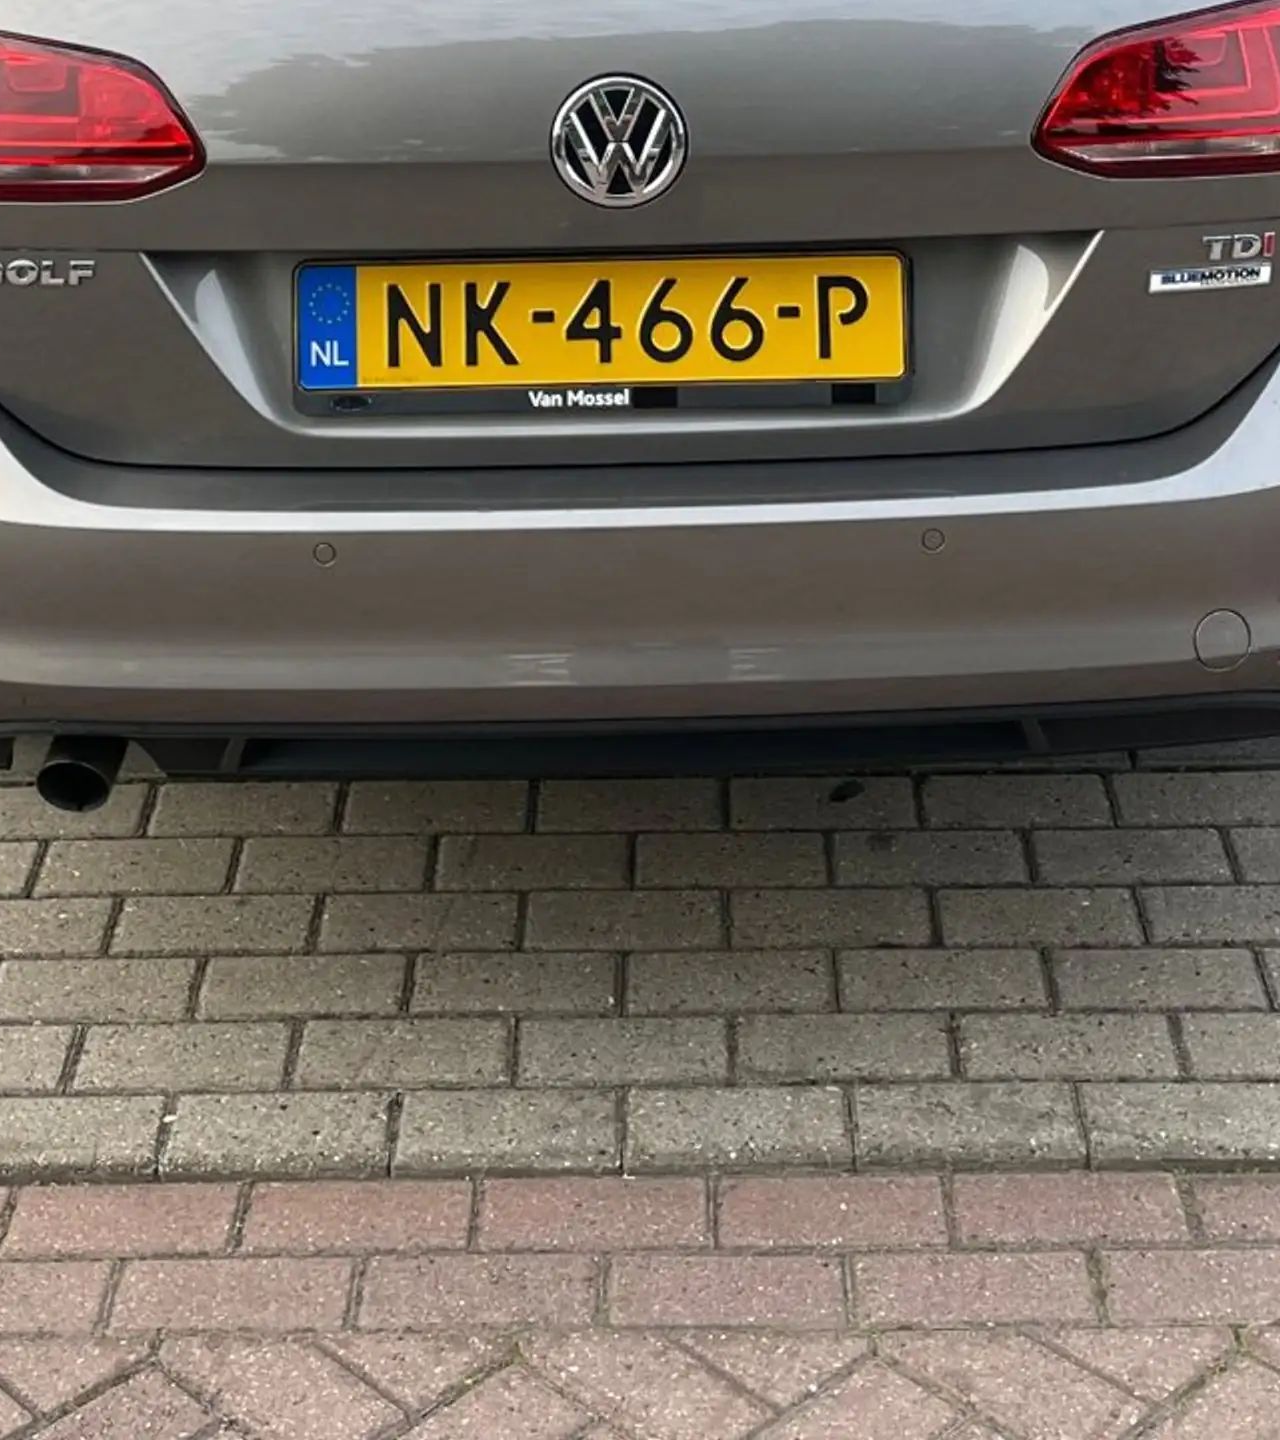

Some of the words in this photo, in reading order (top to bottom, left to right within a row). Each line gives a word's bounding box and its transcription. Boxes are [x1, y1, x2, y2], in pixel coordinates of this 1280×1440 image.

[387, 276, 869, 367] NK-466-P
[310, 340, 349, 366] NL
[529, 391, 562, 407] Van
[568, 389, 629, 406] Mossel
